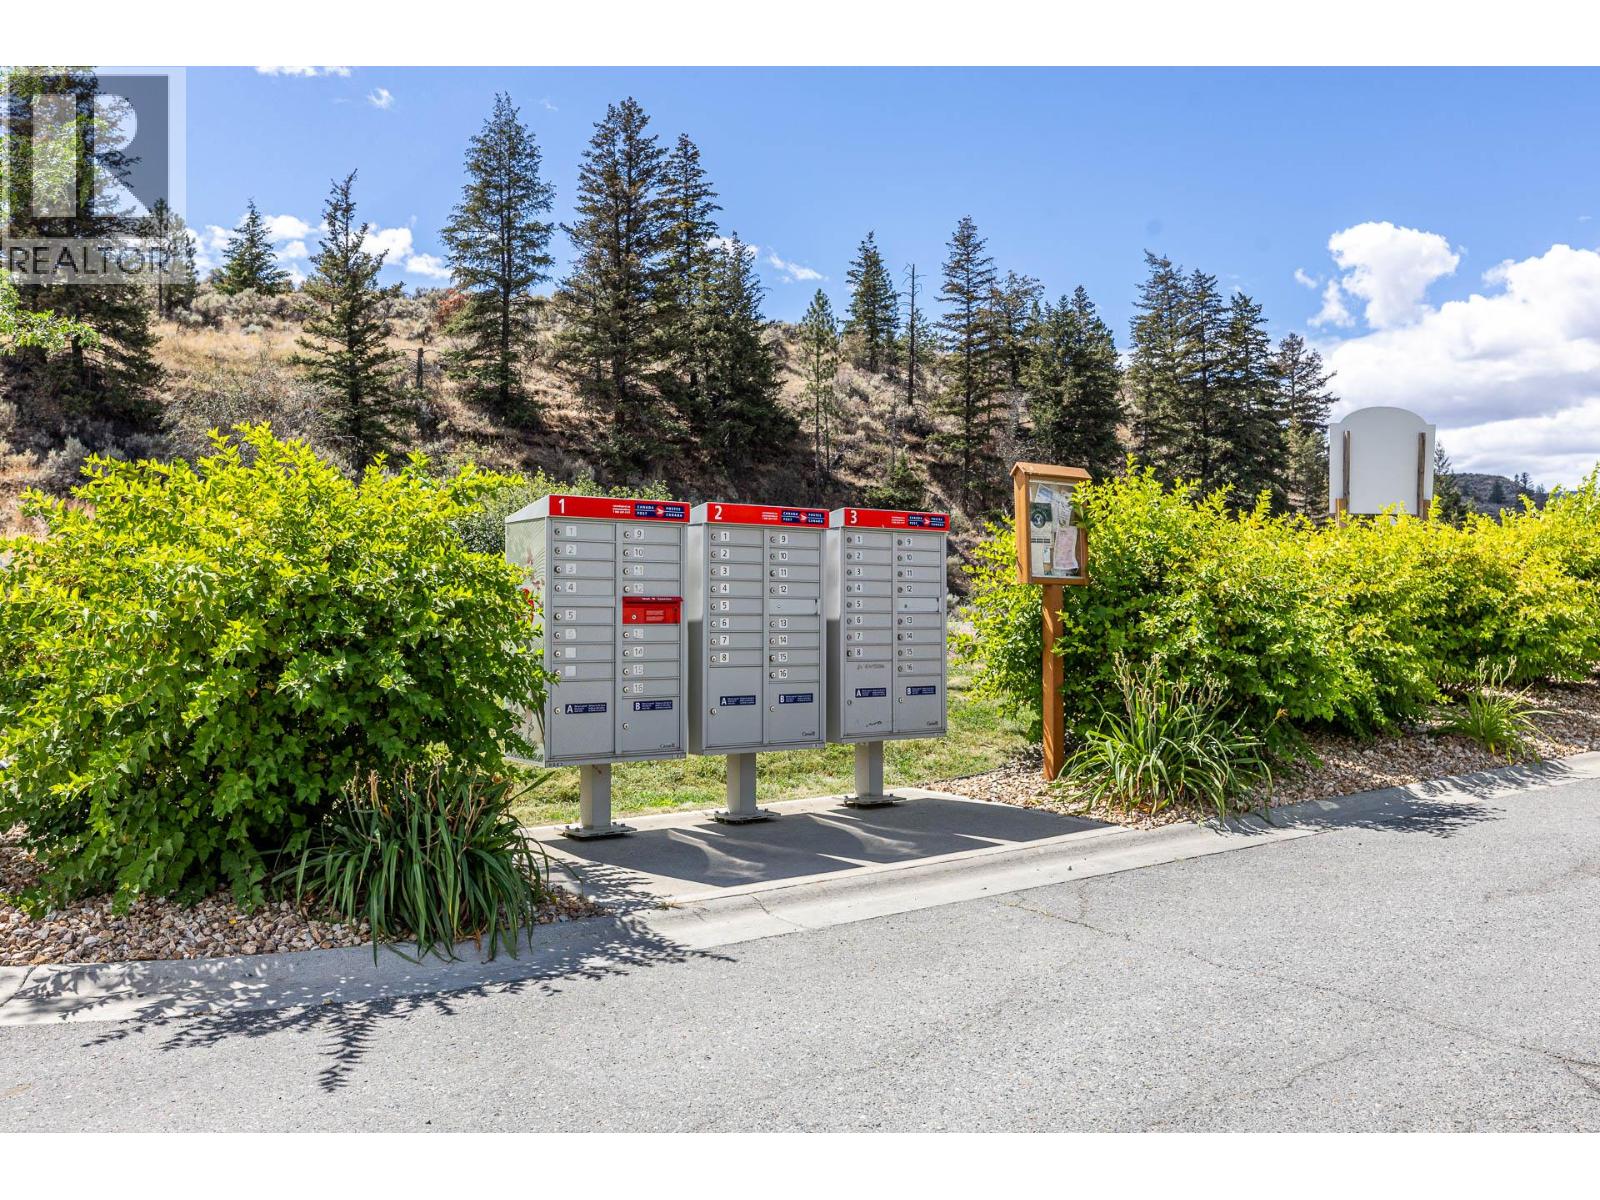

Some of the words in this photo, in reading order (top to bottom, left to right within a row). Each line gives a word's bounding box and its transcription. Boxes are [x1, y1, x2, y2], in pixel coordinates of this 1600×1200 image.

[558, 498, 565, 514] 1
[714, 505, 722, 520] 2
[850, 510, 858, 524] 3
[720, 697, 728, 706] A
[780, 695, 785, 703] B
[566, 704, 574, 714] A
[635, 702, 641, 710] B
